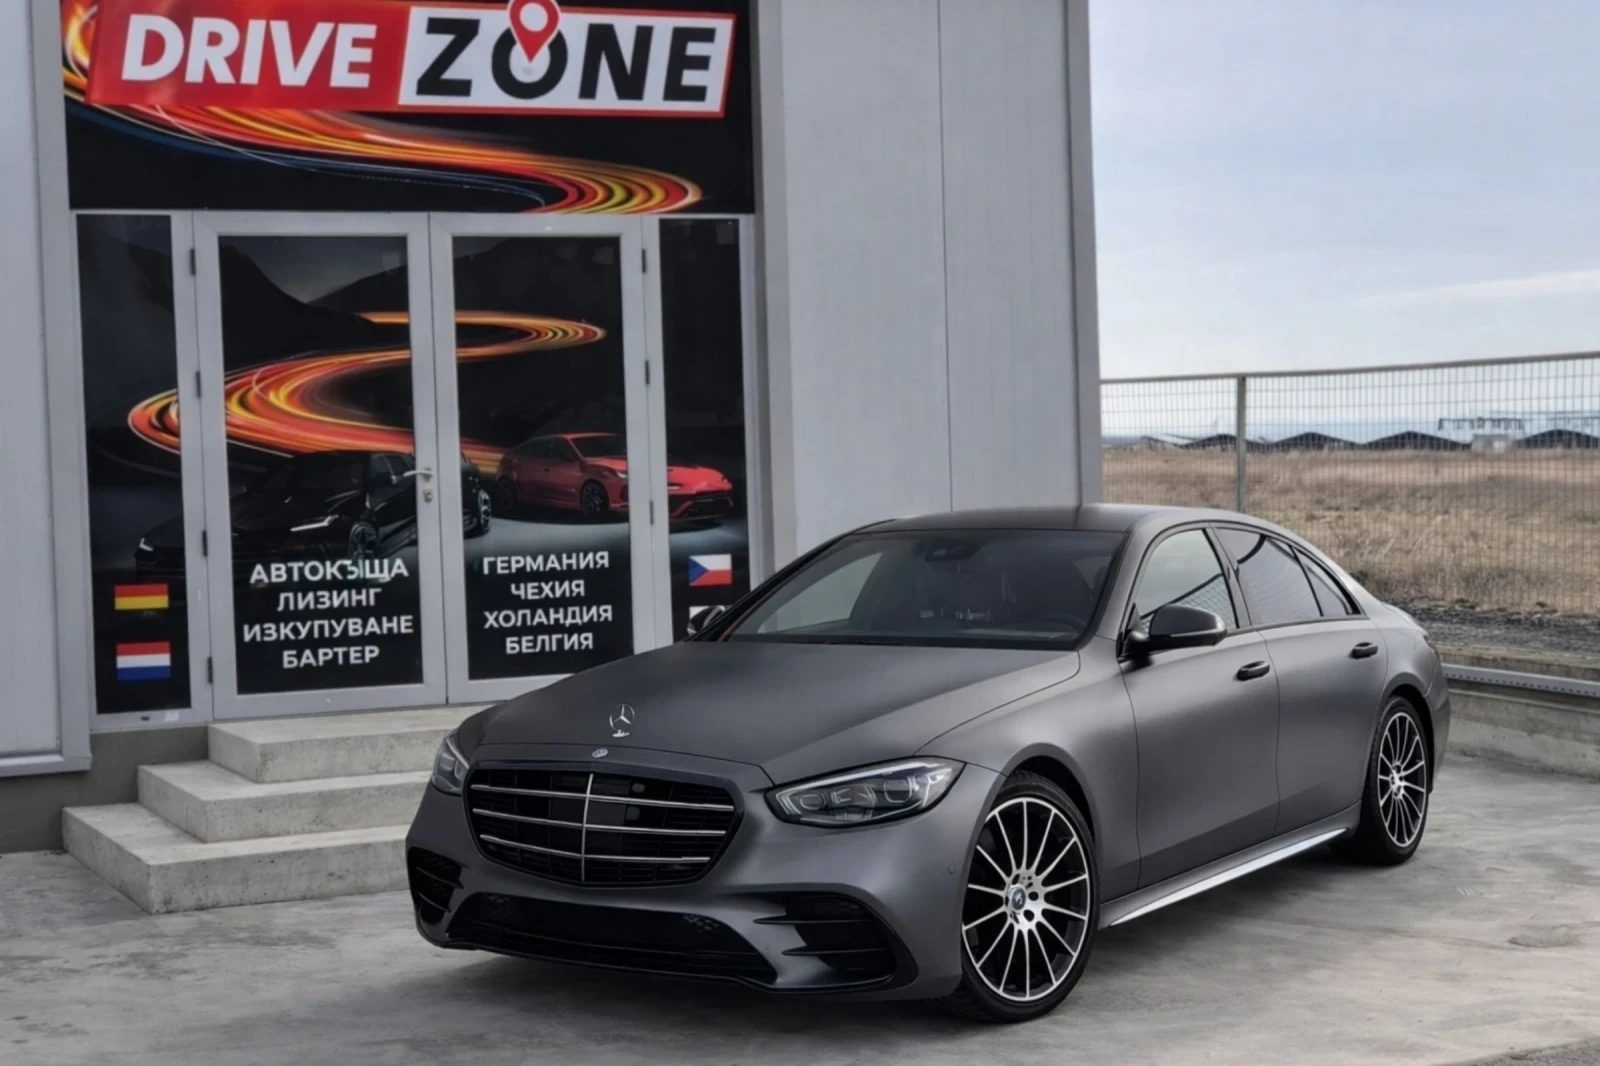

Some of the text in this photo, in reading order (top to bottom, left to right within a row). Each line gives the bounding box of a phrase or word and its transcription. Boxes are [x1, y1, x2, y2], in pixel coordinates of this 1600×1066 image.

[121, 14, 716, 101] DRIVE ZONE
[482, 551, 609, 574] ГЕРМАНИЯ
[277, 588, 382, 611] ЛИЗИНГ
[510, 580, 585, 600] ЧЕХИЯ
[483, 605, 613, 628] ХОЛАНДИЯ
[243, 615, 414, 642] ИЗКУПУВАНЕ
[505, 633, 594, 654] БЕЛГИЯ
[282, 646, 379, 668] БАРТЕР
